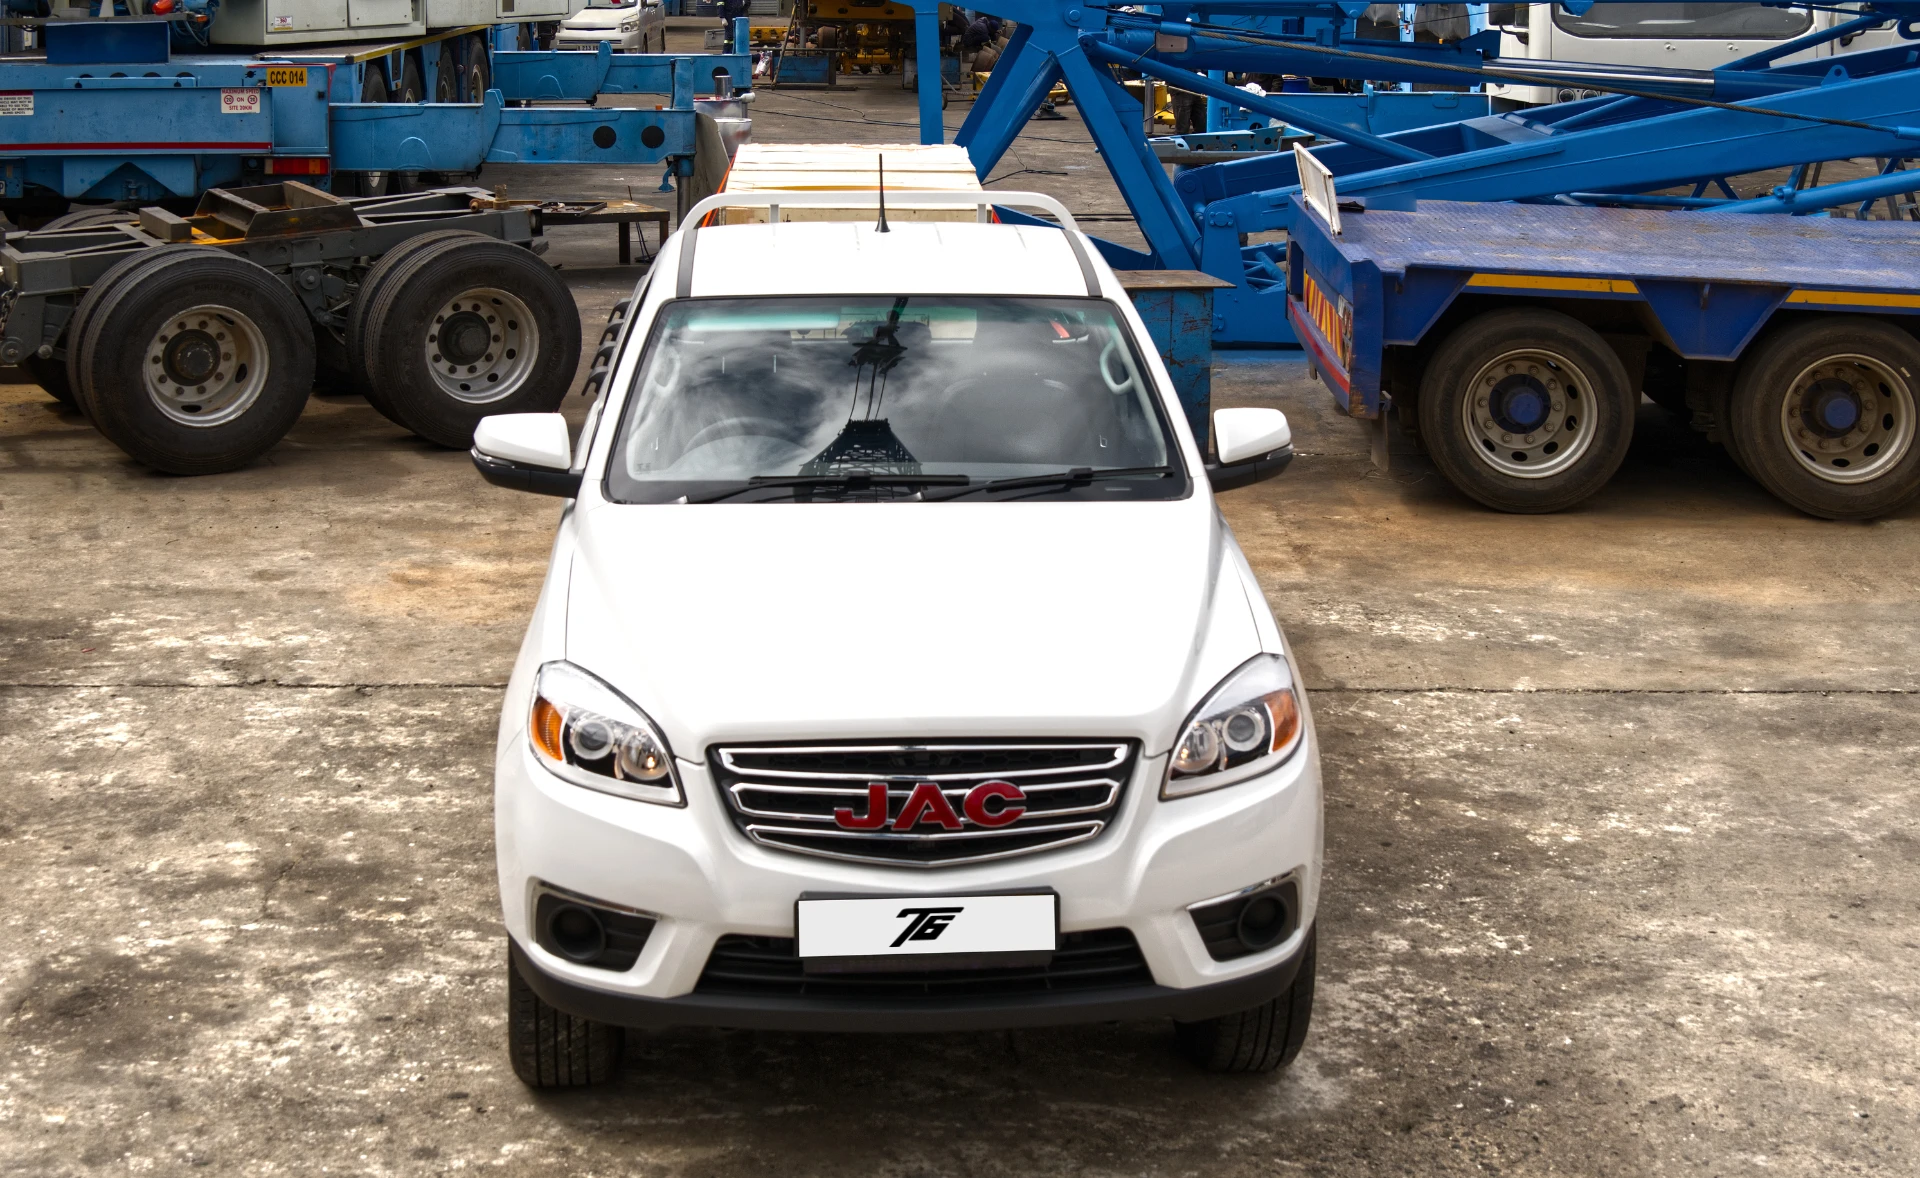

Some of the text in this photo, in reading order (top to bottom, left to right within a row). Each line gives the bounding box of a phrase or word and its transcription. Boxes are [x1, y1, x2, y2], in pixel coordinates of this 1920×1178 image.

[270, 71, 304, 84] CCC 014
[833, 779, 1027, 831] JAC
[889, 906, 965, 948] T6
